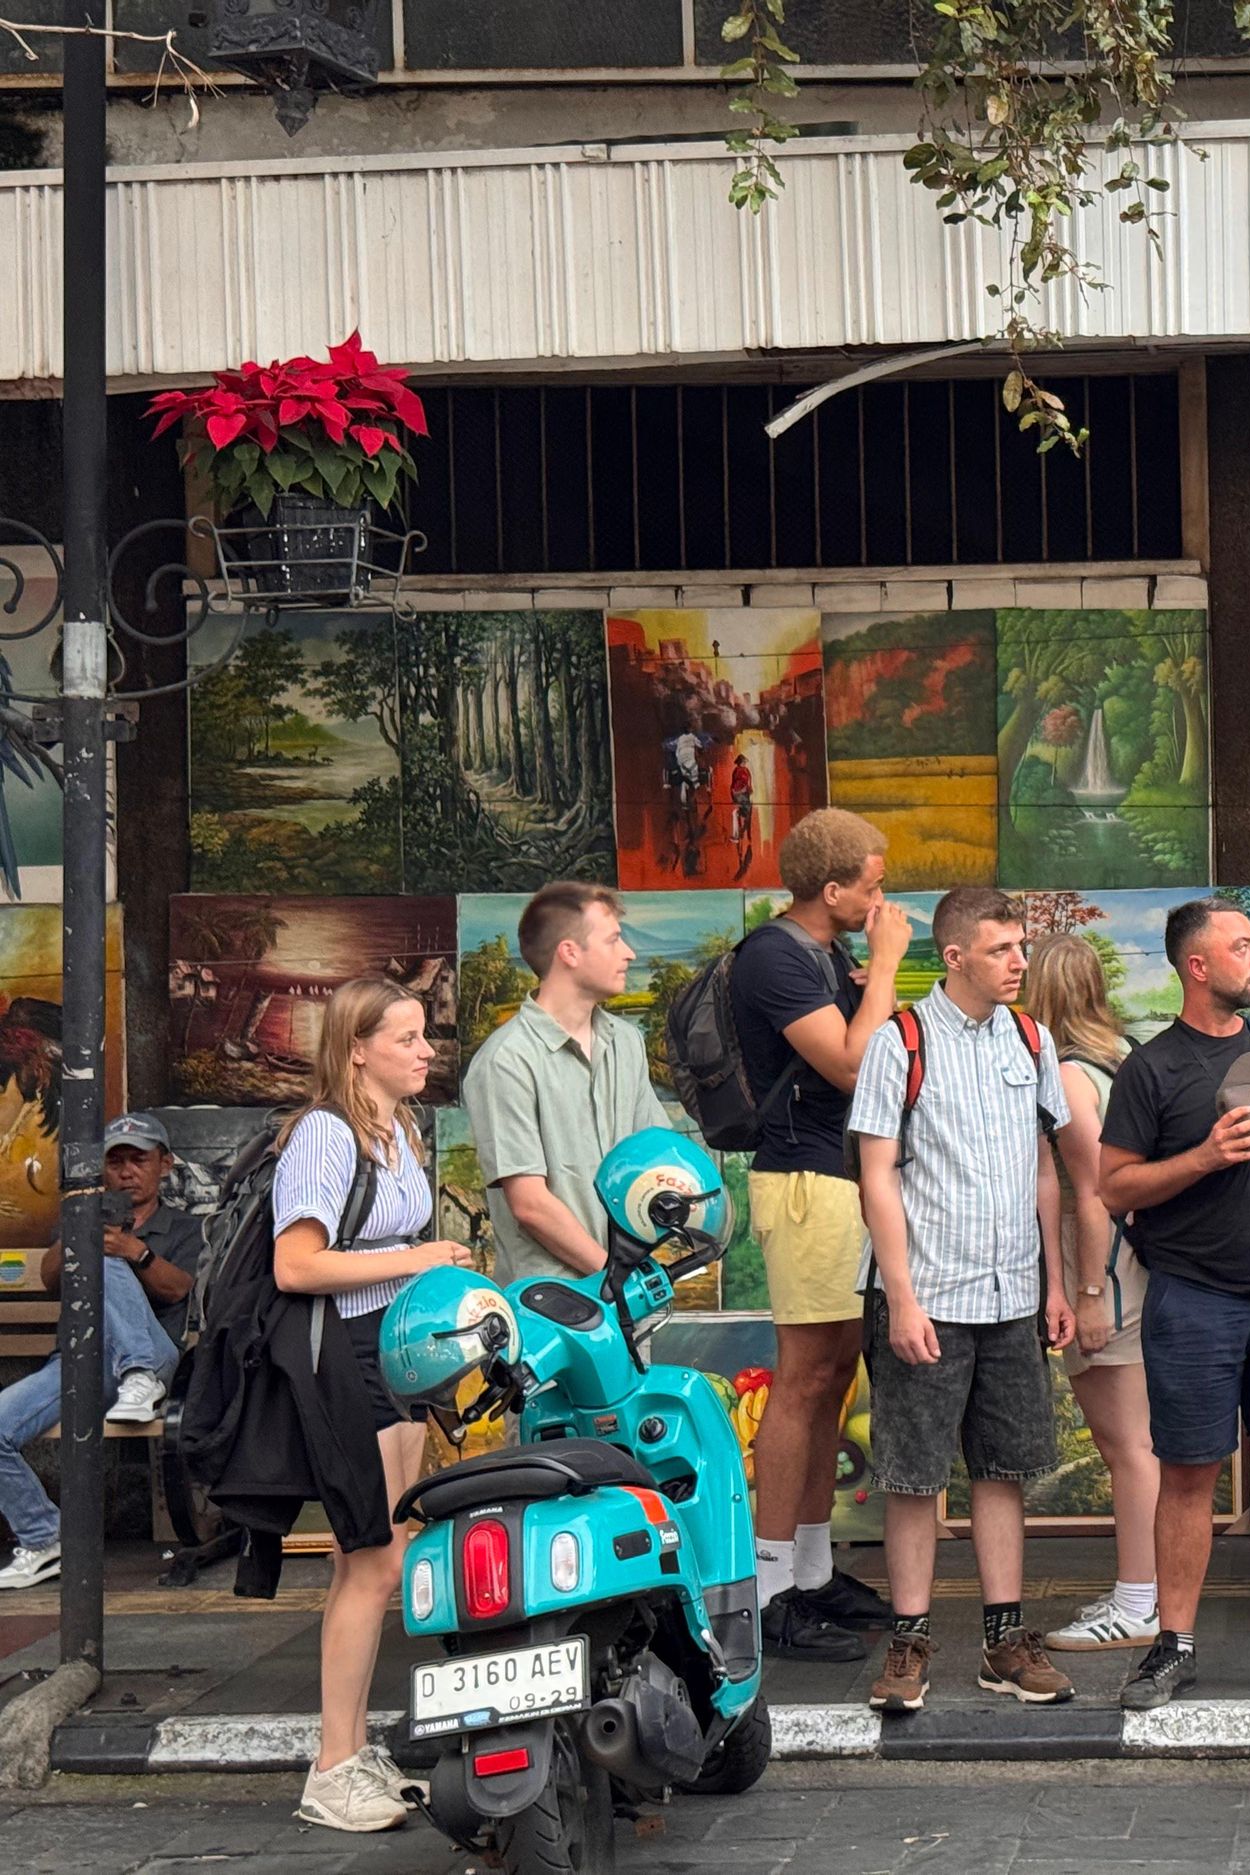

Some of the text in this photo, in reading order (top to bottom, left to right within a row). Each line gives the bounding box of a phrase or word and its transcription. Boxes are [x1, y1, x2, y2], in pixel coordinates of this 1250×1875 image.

[422, 1646, 578, 1698] D 3160 AEV
[425, 1718, 459, 1733] YAMAHA
